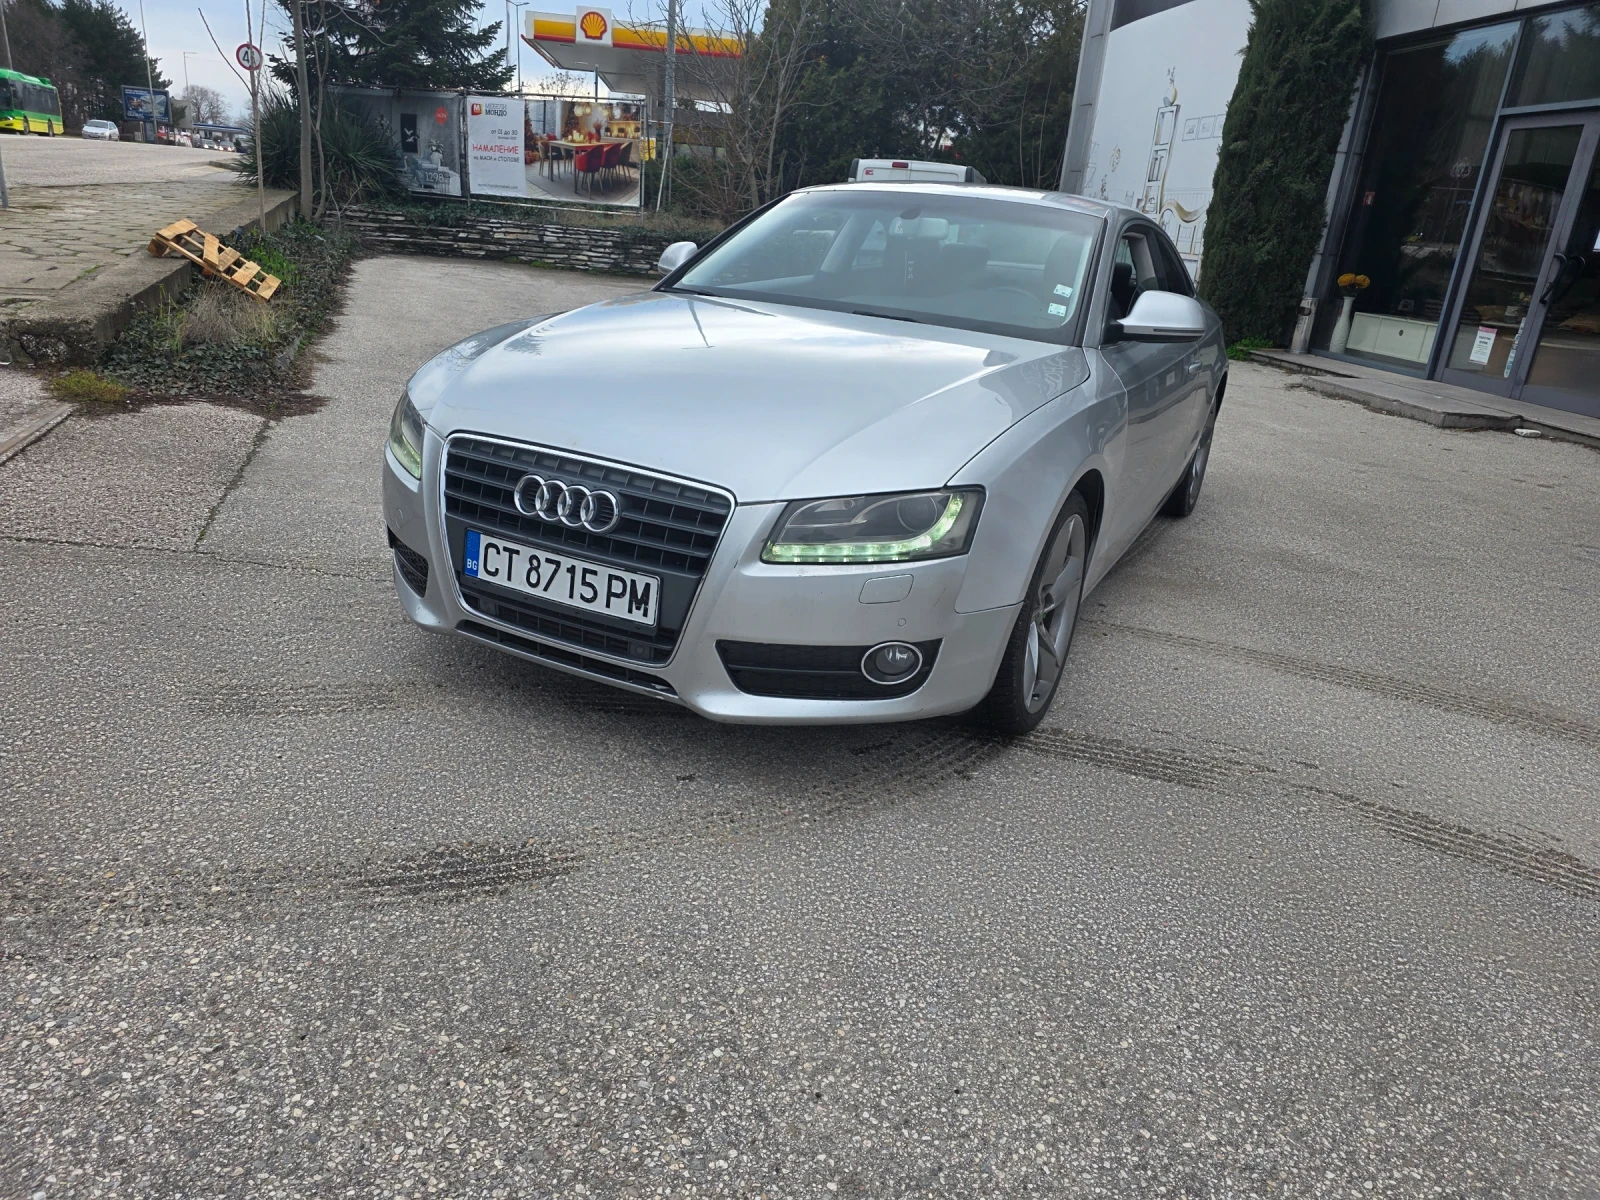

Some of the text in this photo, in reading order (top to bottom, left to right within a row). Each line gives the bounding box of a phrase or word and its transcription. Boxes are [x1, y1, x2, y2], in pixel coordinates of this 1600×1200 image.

[472, 144, 519, 154] НАМАЛЕНИЕ
[424, 172, 444, 182] 1298
[466, 558, 478, 571] BG
[483, 542, 651, 618] CT 8715 PM
